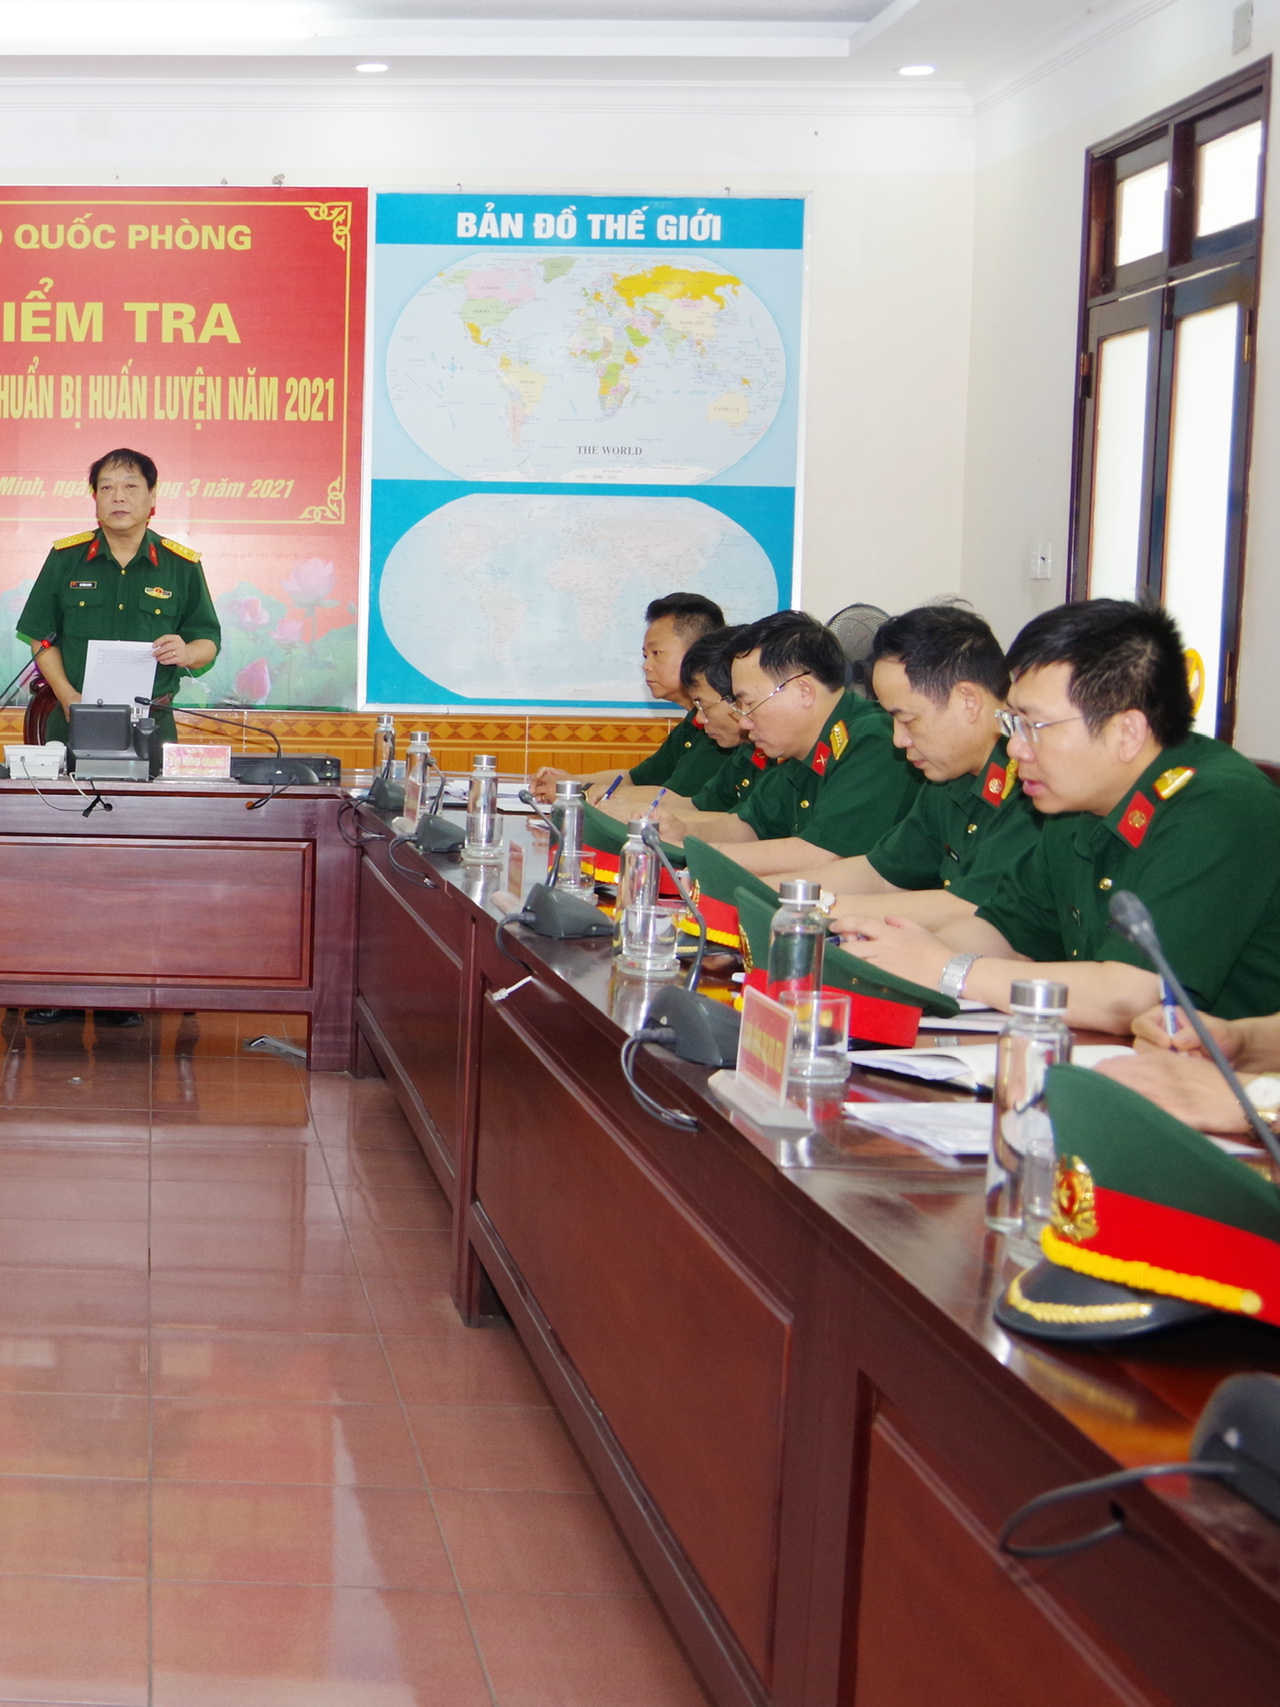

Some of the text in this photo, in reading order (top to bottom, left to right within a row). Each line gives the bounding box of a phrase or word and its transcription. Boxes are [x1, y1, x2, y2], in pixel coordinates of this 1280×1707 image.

[14, 213, 117, 250] QUỐC
[127, 218, 253, 251] PHÒNG
[456, 202, 721, 242] BẢN ĐỒ THẾ GIỚI
[123, 302, 242, 344] TRA
[60, 375, 82, 429] BỊ
[88, 359, 148, 421] HUẤN
[154, 367, 222, 430] LUYỆN
[228, 367, 279, 422] NĂM
[285, 377, 335, 422] 2021
[576, 445, 643, 456] THE WORLD
[186, 477, 201, 498] 3
[202, 477, 245, 498] năm
[247, 479, 295, 499] 2021
